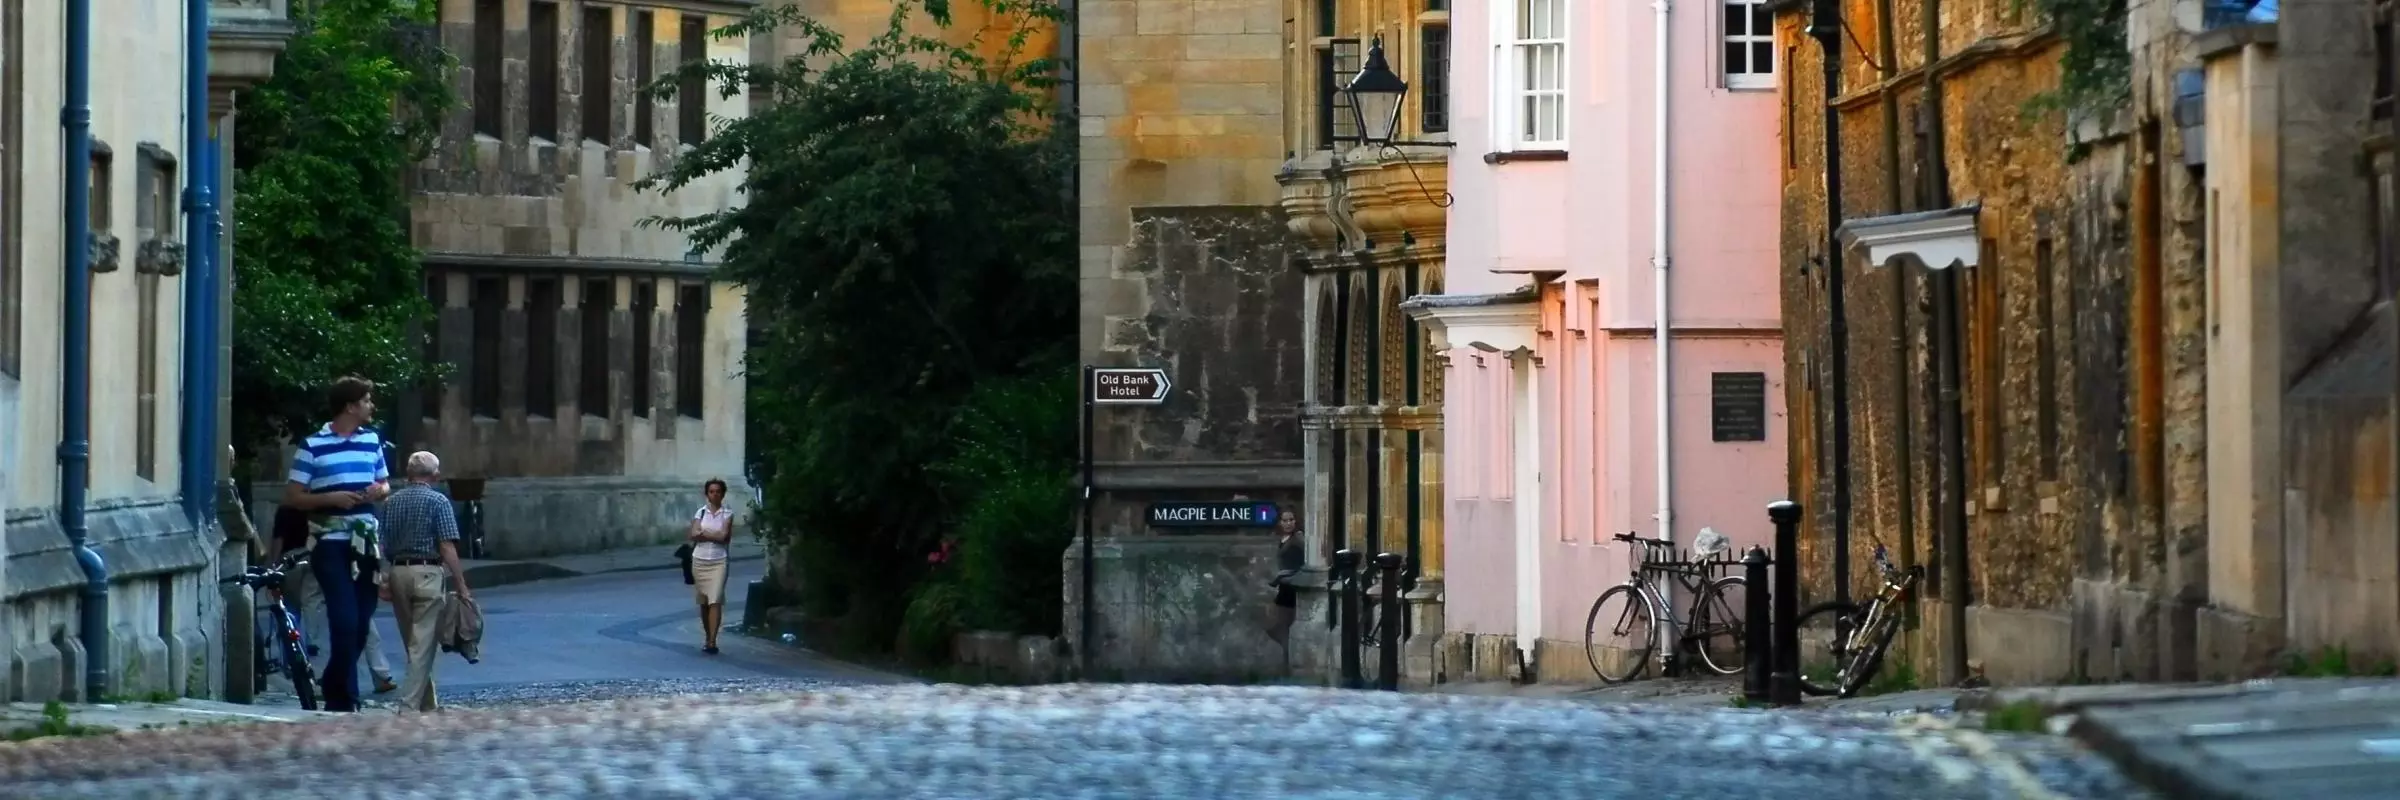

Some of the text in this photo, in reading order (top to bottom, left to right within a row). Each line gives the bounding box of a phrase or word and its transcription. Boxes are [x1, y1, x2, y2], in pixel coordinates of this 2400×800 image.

[1100, 374, 1149, 384] Old Bank
[1110, 386, 1139, 395] Hotel
[1154, 507, 1251, 520] MAGPIE LANE
